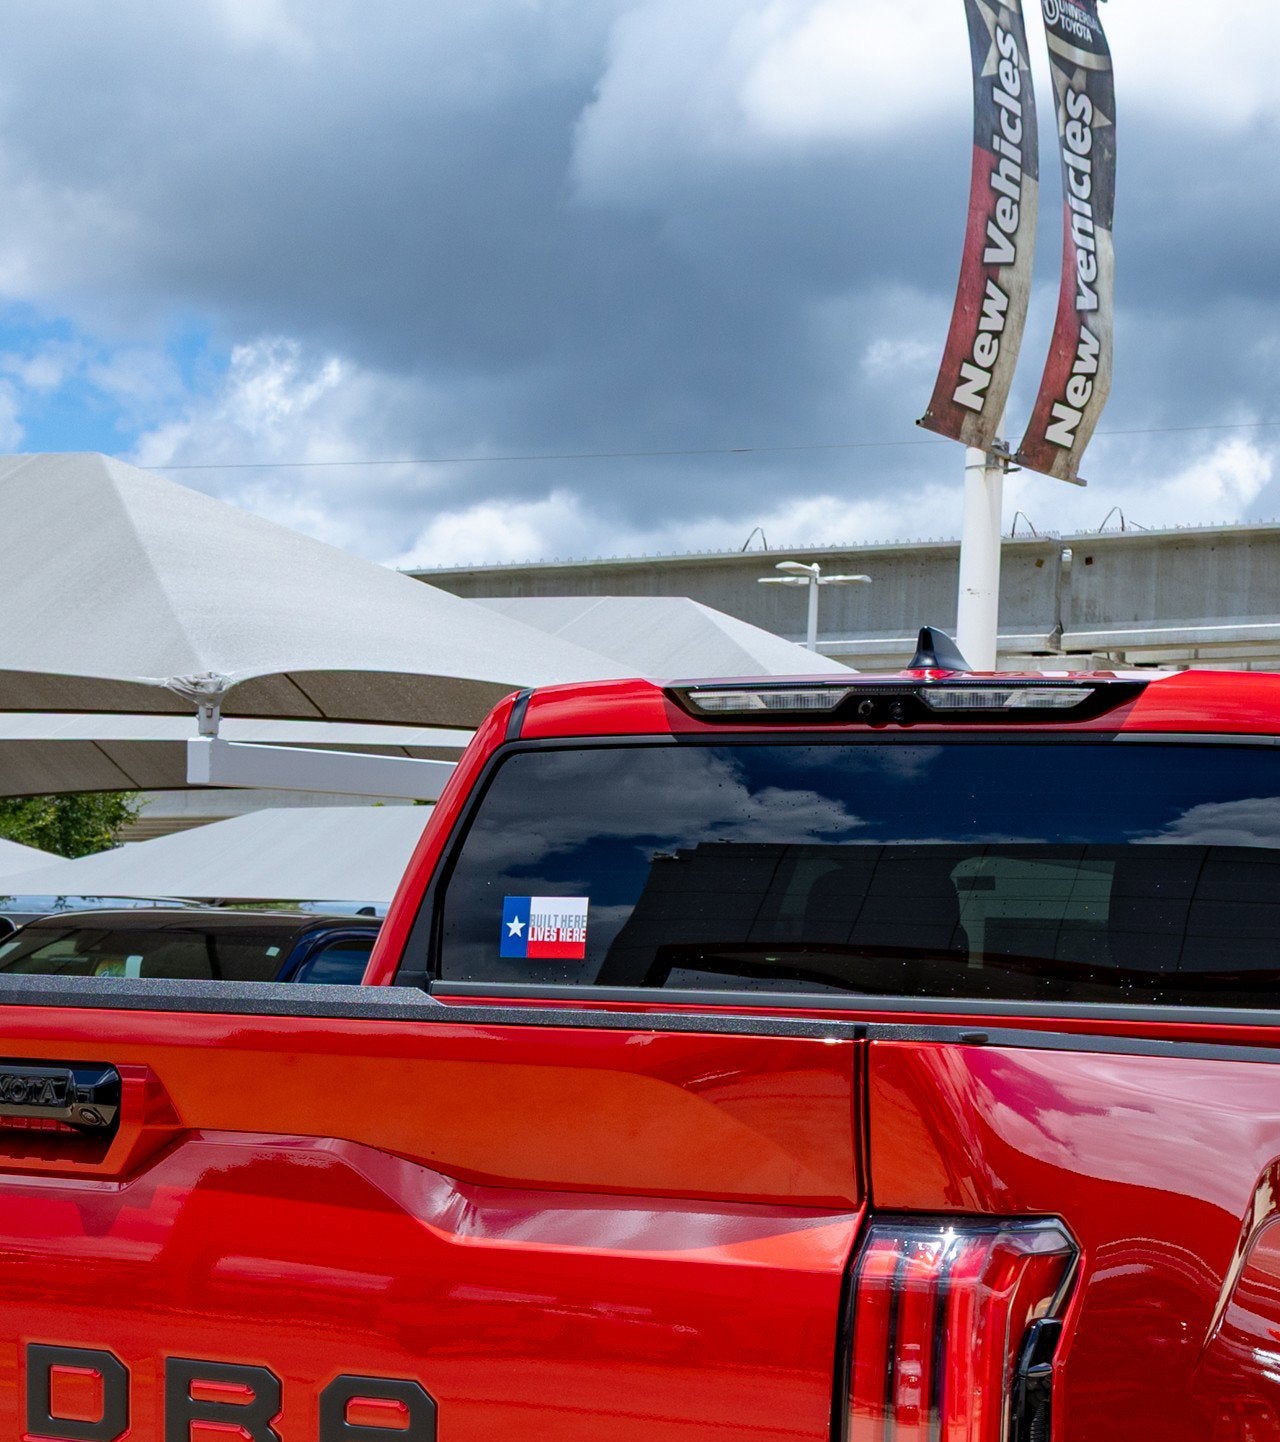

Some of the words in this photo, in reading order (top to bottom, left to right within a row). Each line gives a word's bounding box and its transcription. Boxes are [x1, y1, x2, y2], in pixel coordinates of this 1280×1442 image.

[1060, 14, 1093, 43] TOYOTA
[952, 279, 1010, 412] New
[983, 26, 1024, 264] Vehicles
[1044, 326, 1101, 448] New
[528, 927, 557, 942] LIVES
[559, 928, 587, 943] HERE
[529, 914, 559, 928] BUILT
[561, 914, 587, 928] HERE
